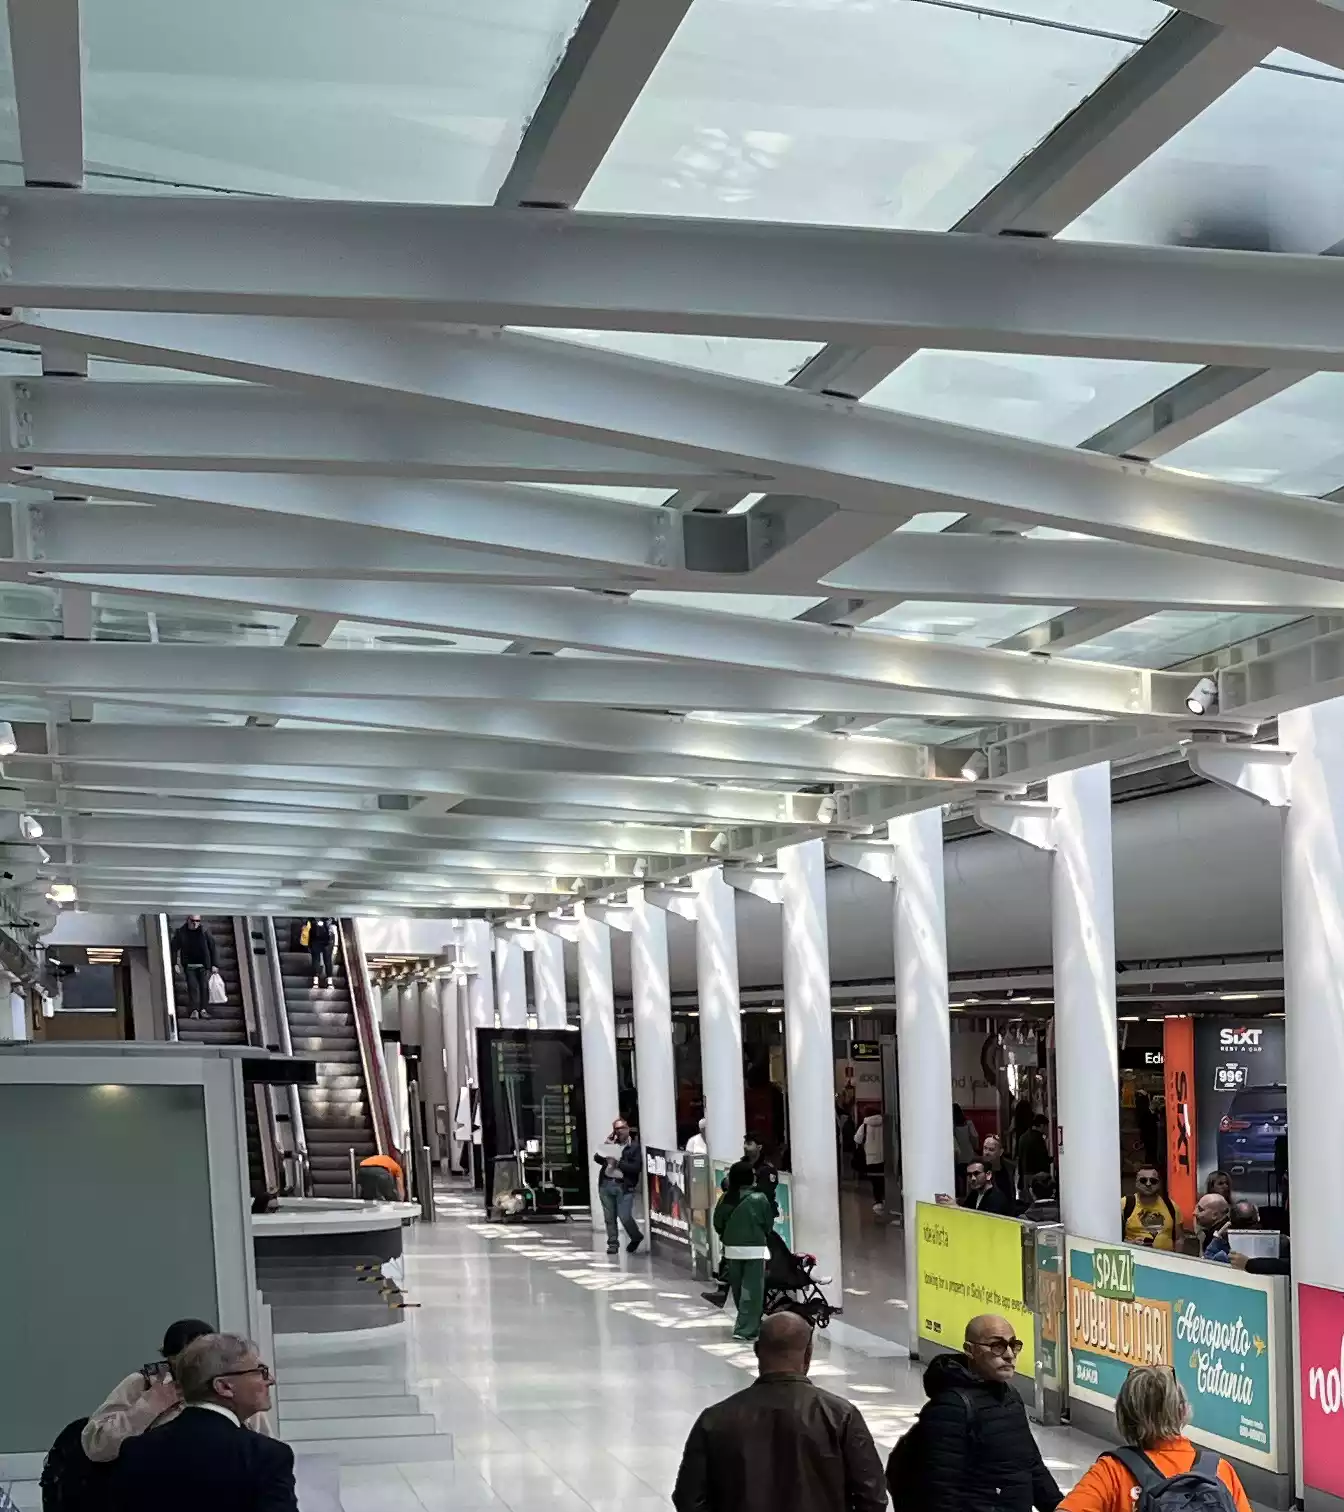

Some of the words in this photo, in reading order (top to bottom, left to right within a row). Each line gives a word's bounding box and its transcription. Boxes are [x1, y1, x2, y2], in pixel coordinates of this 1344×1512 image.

[1218, 1070, 1243, 1083] 99€
[1096, 1254, 1132, 1292] SPAZI
[1073, 1287, 1168, 1365] PUBBLICITARI
[1176, 1302, 1251, 1360] Aeroporto
[1197, 1353, 1253, 1405] Catania
